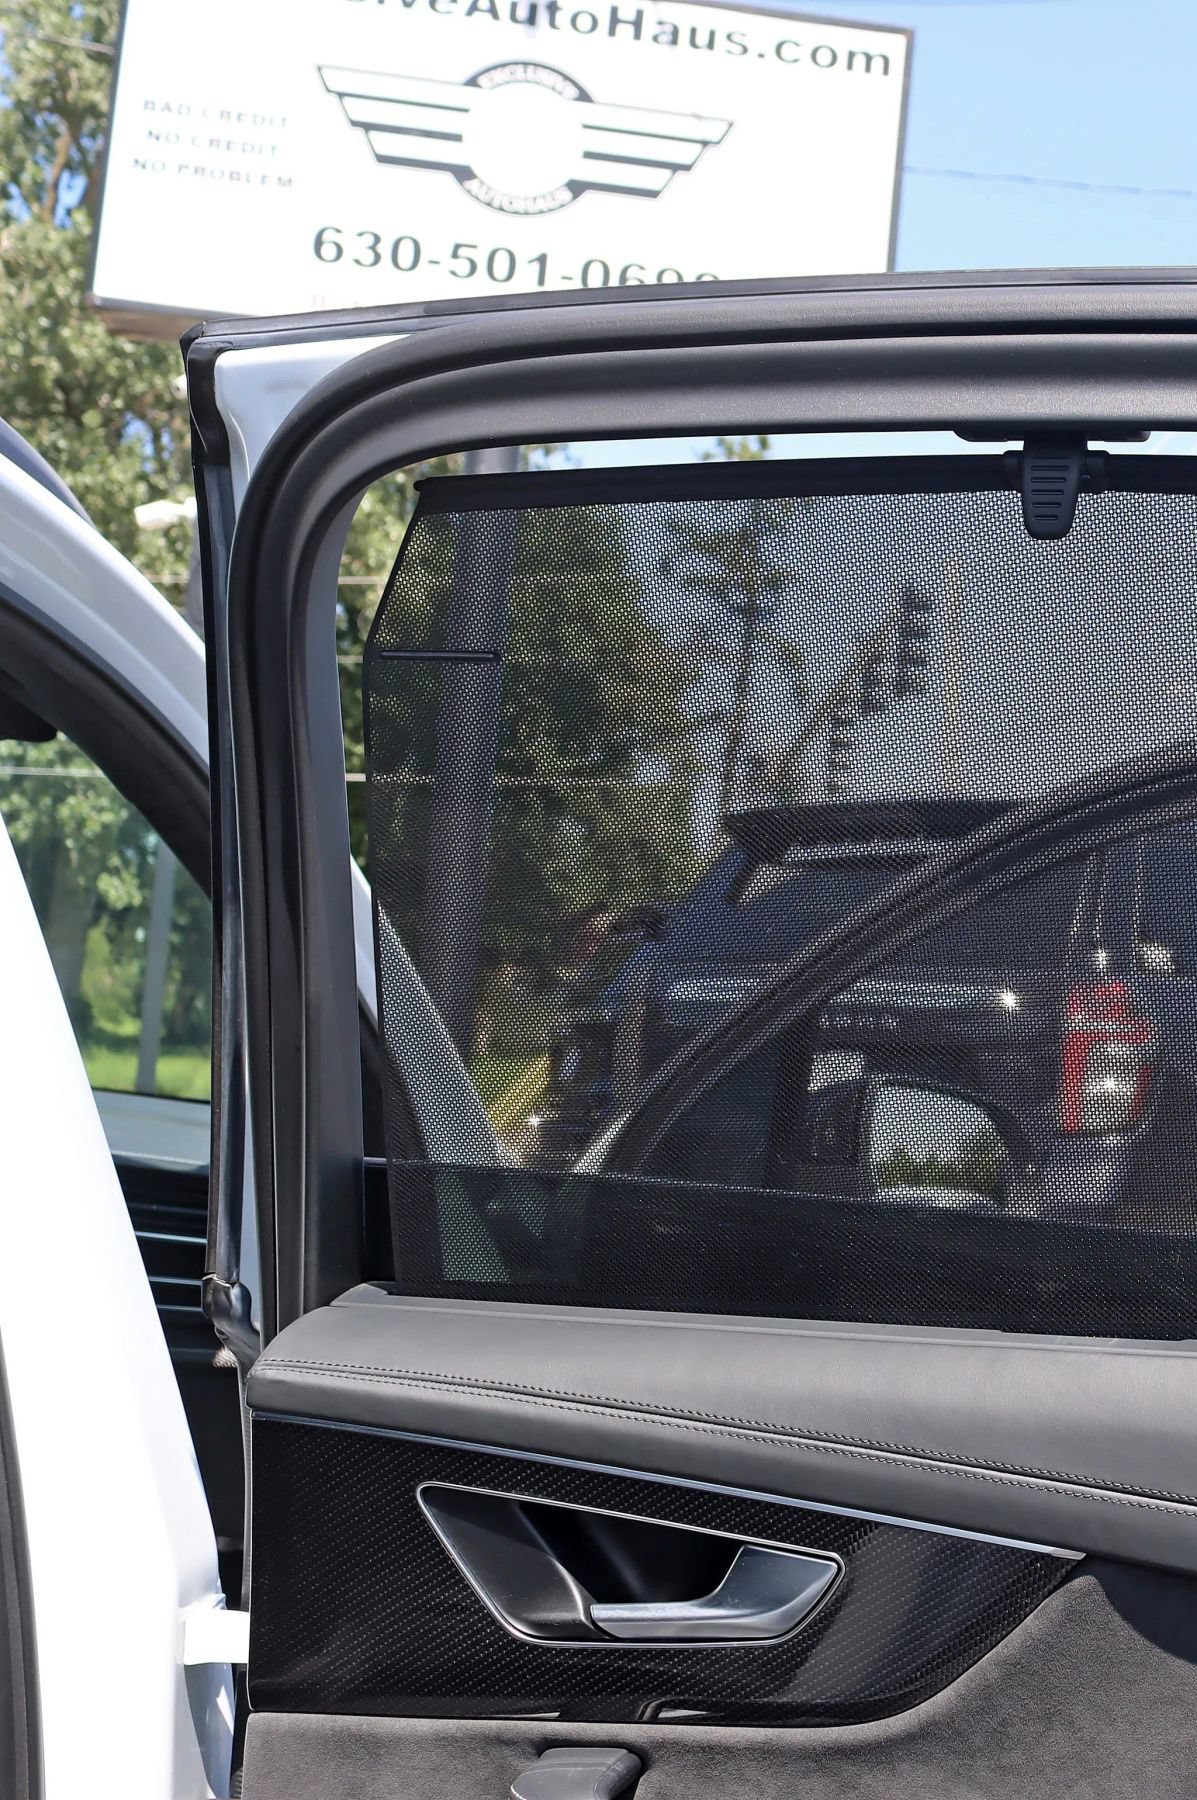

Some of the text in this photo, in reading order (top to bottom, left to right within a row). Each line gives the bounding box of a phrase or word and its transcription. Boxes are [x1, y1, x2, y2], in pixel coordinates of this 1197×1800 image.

[144, 99, 288, 128] BAD CREDIT
[146, 129, 278, 157] NO CREDIT
[132, 157, 294, 188] NO PROBLEM
